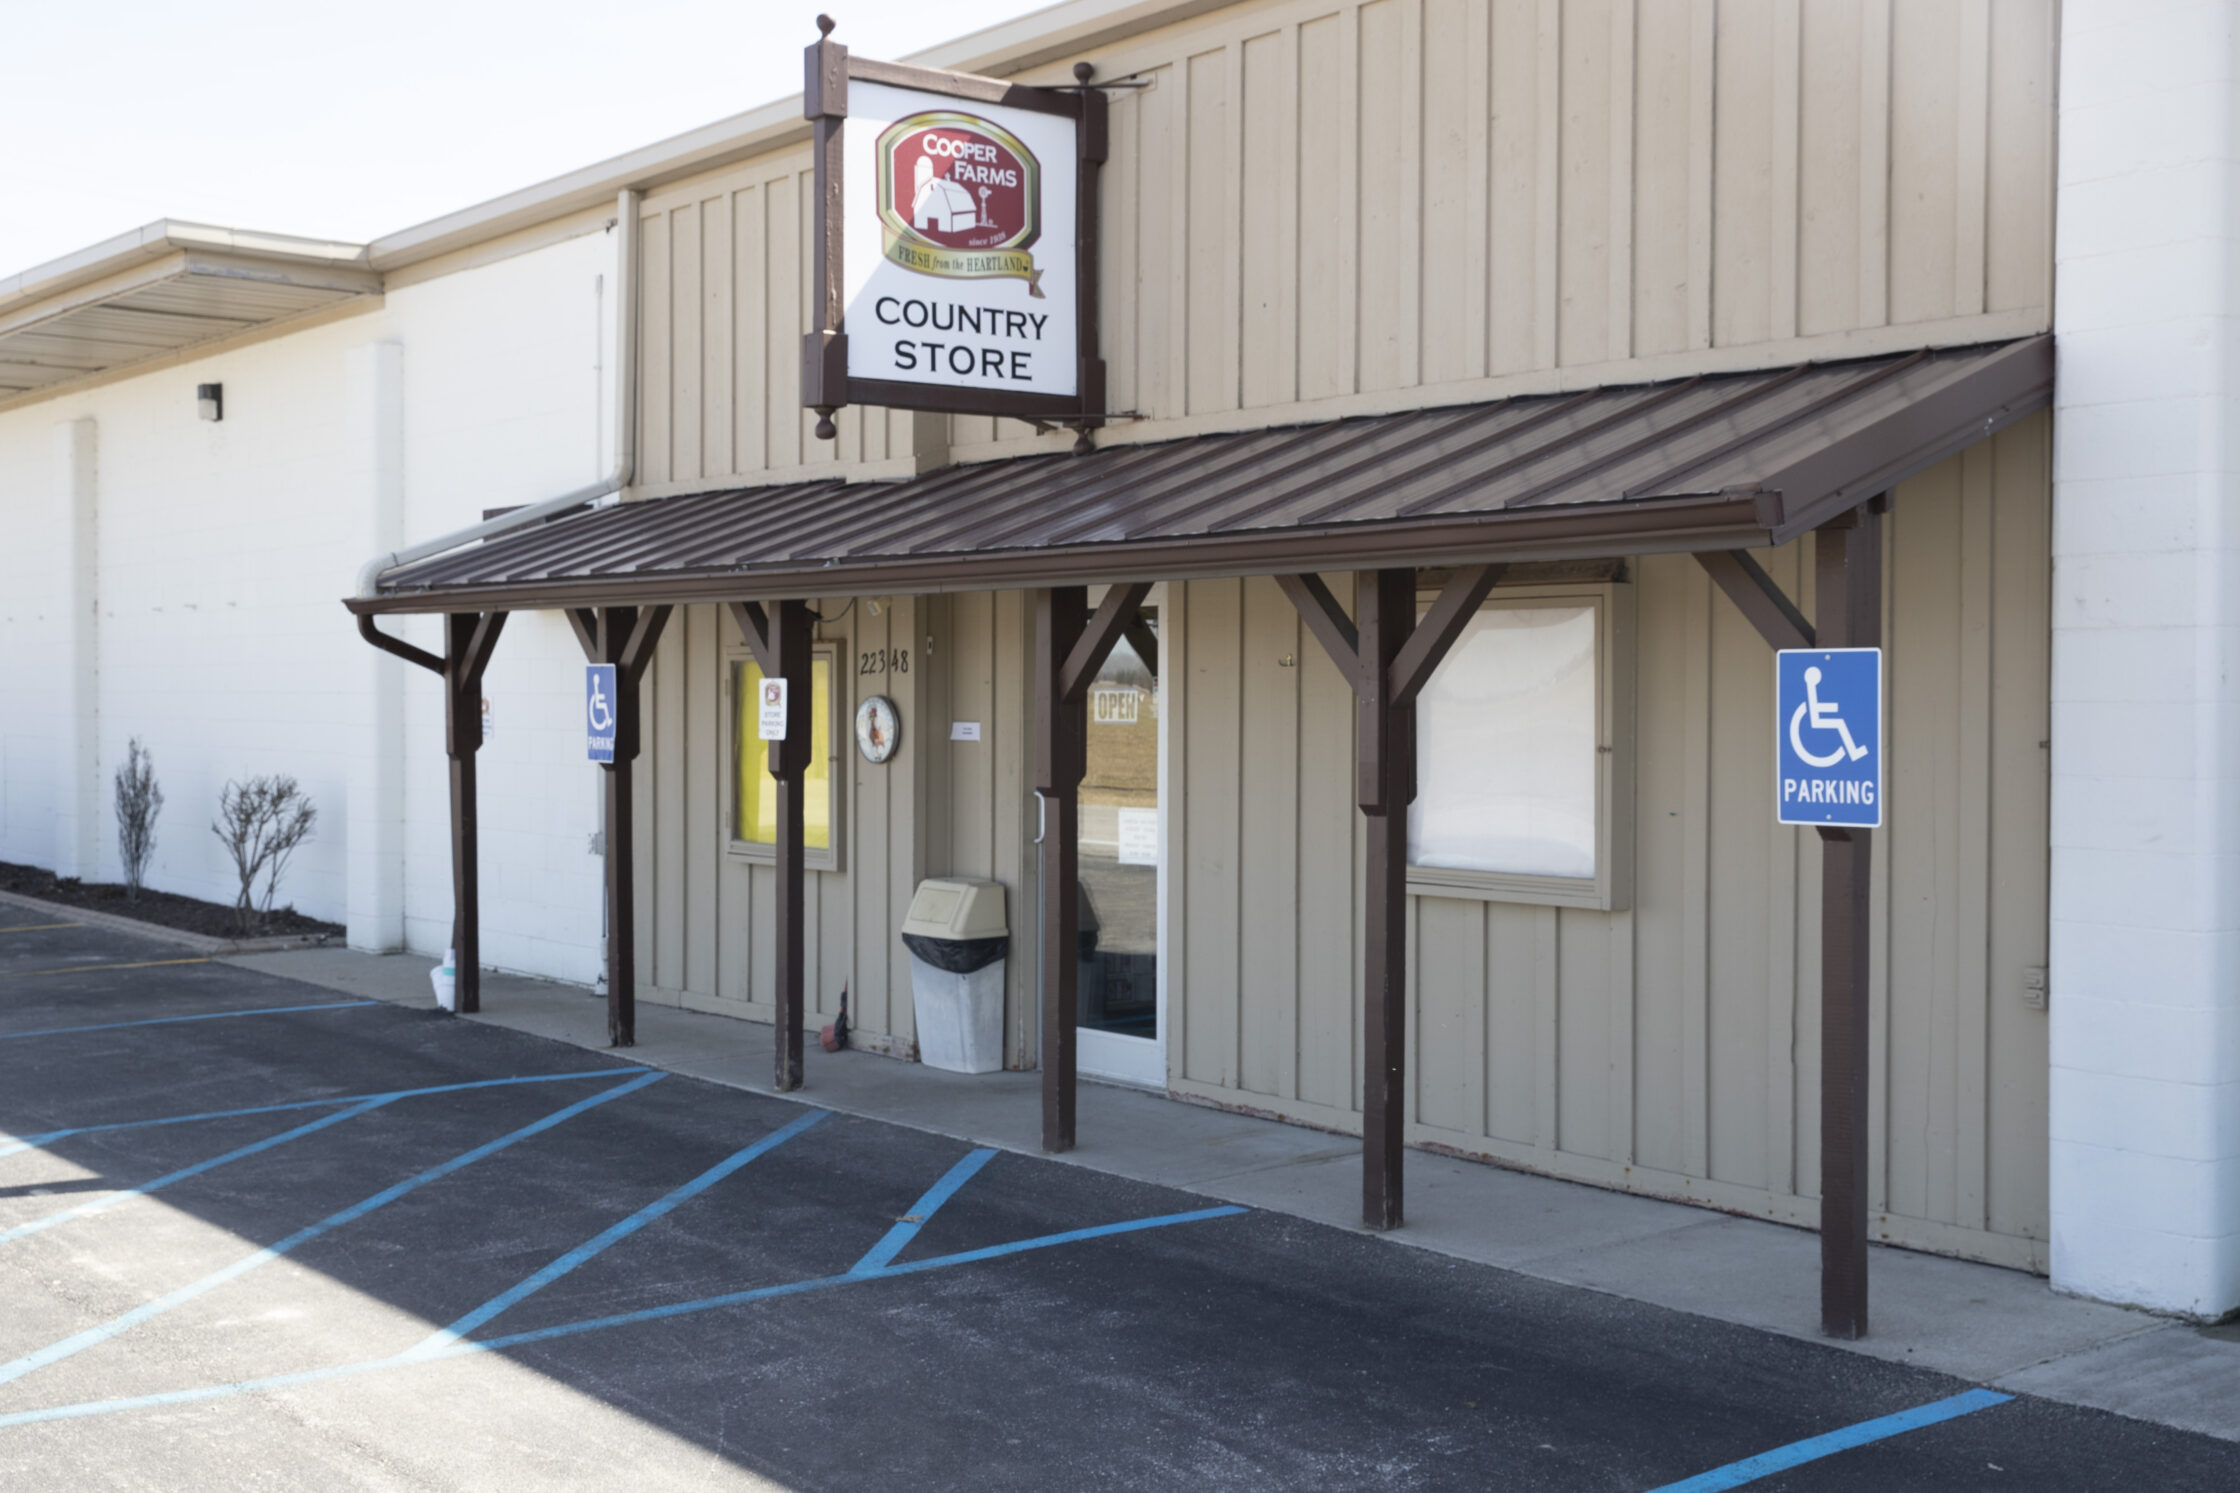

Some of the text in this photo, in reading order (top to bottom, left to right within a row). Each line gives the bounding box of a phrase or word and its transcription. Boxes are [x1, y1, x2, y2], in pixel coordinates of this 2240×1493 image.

[923, 134, 997, 163] COOPER
[954, 160, 1017, 187] FARMS
[898, 245, 1022, 272] FRESH from the HEARTLAND
[875, 296, 1048, 340] COUNTRY
[894, 340, 1033, 381] STORE
[860, 648, 909, 676] 22348
[1098, 692, 1135, 719] OPEN
[1784, 779, 1874, 805] PARKING
